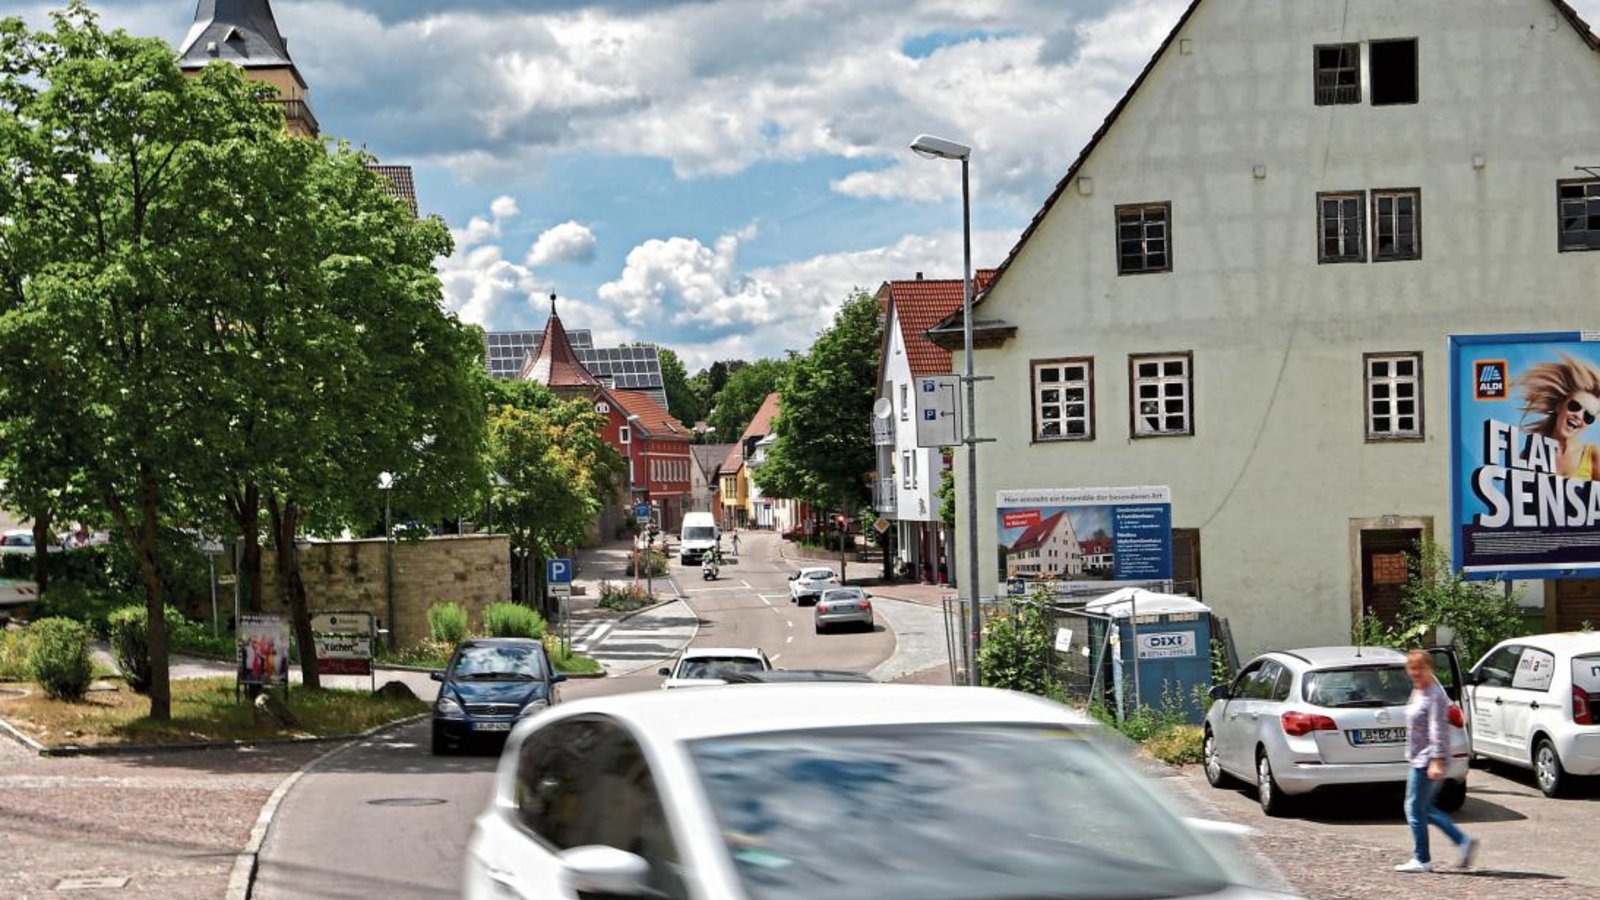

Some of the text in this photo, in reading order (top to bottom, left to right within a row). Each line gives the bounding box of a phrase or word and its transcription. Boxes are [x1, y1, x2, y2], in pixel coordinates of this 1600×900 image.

[1480, 382, 1502, 391] ALDI
[1488, 418, 1561, 475] FLAT
[553, 562, 566, 582] P
